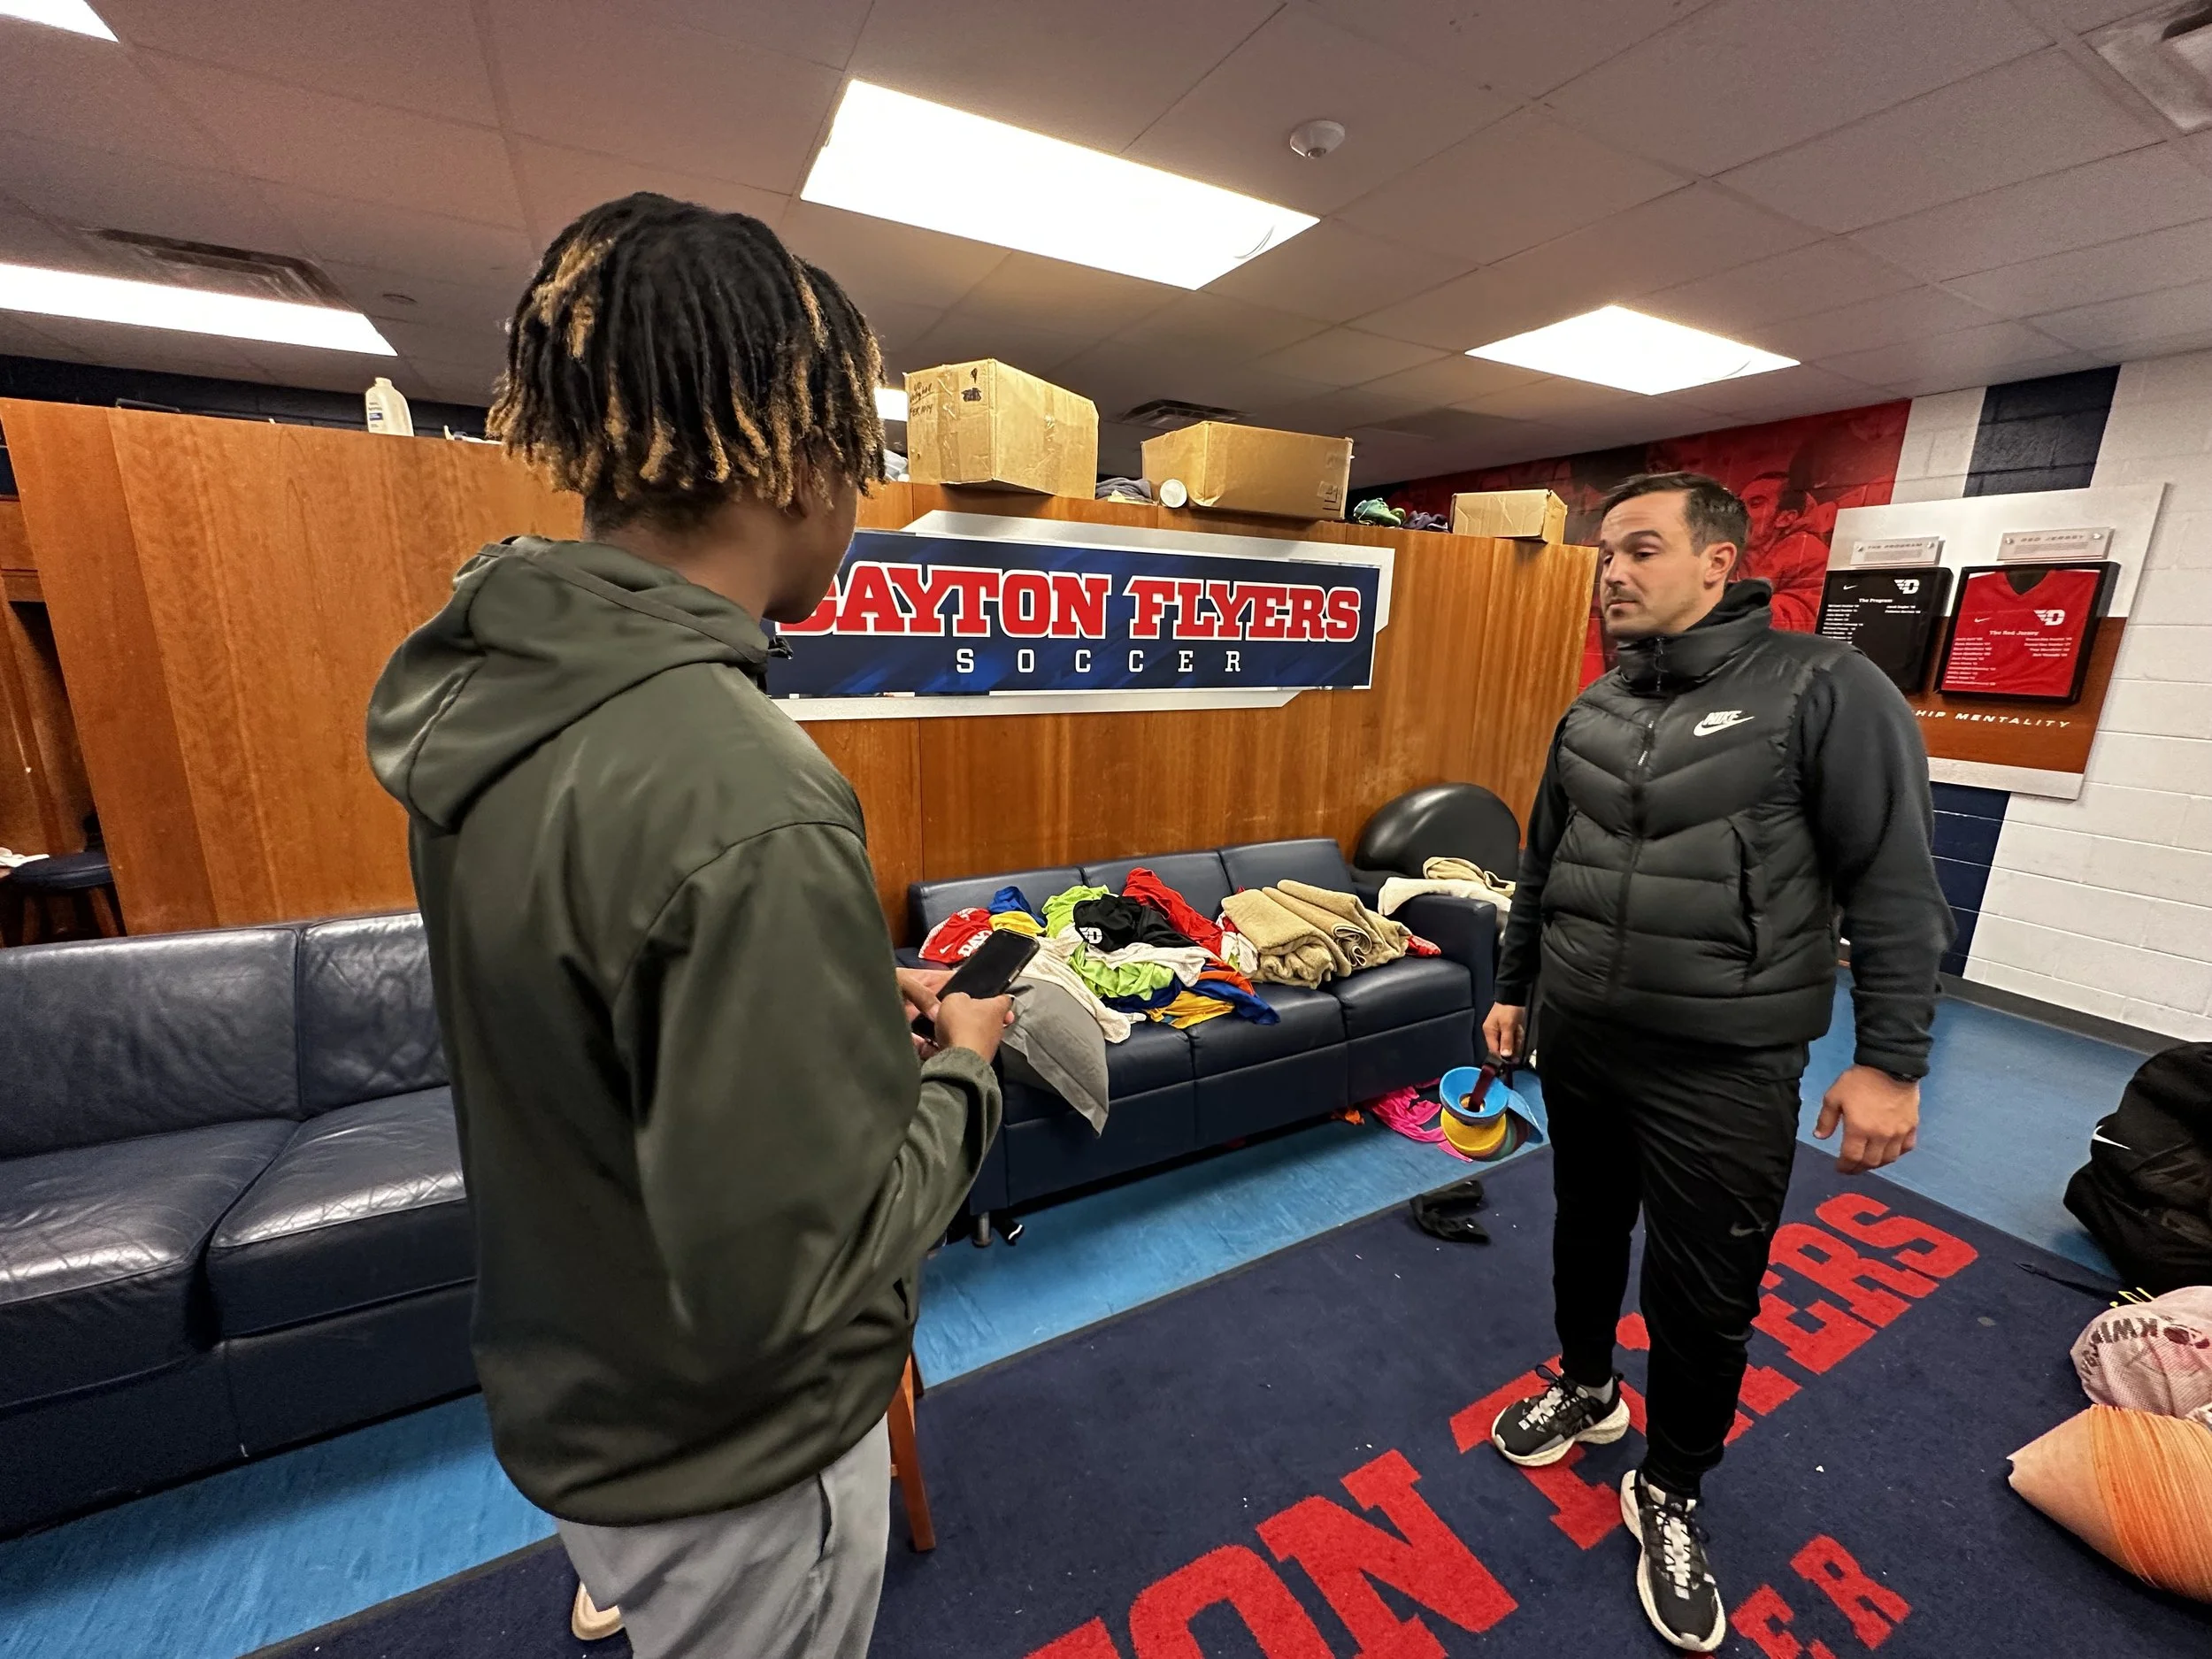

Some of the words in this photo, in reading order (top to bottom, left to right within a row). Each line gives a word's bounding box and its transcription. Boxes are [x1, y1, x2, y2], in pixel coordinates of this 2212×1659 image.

[1124, 575, 1361, 642] FLYERS
[956, 648, 1241, 674] SOCCER
[1701, 710, 1742, 726] NIKE
[1955, 712, 2070, 729] MENTALITY
